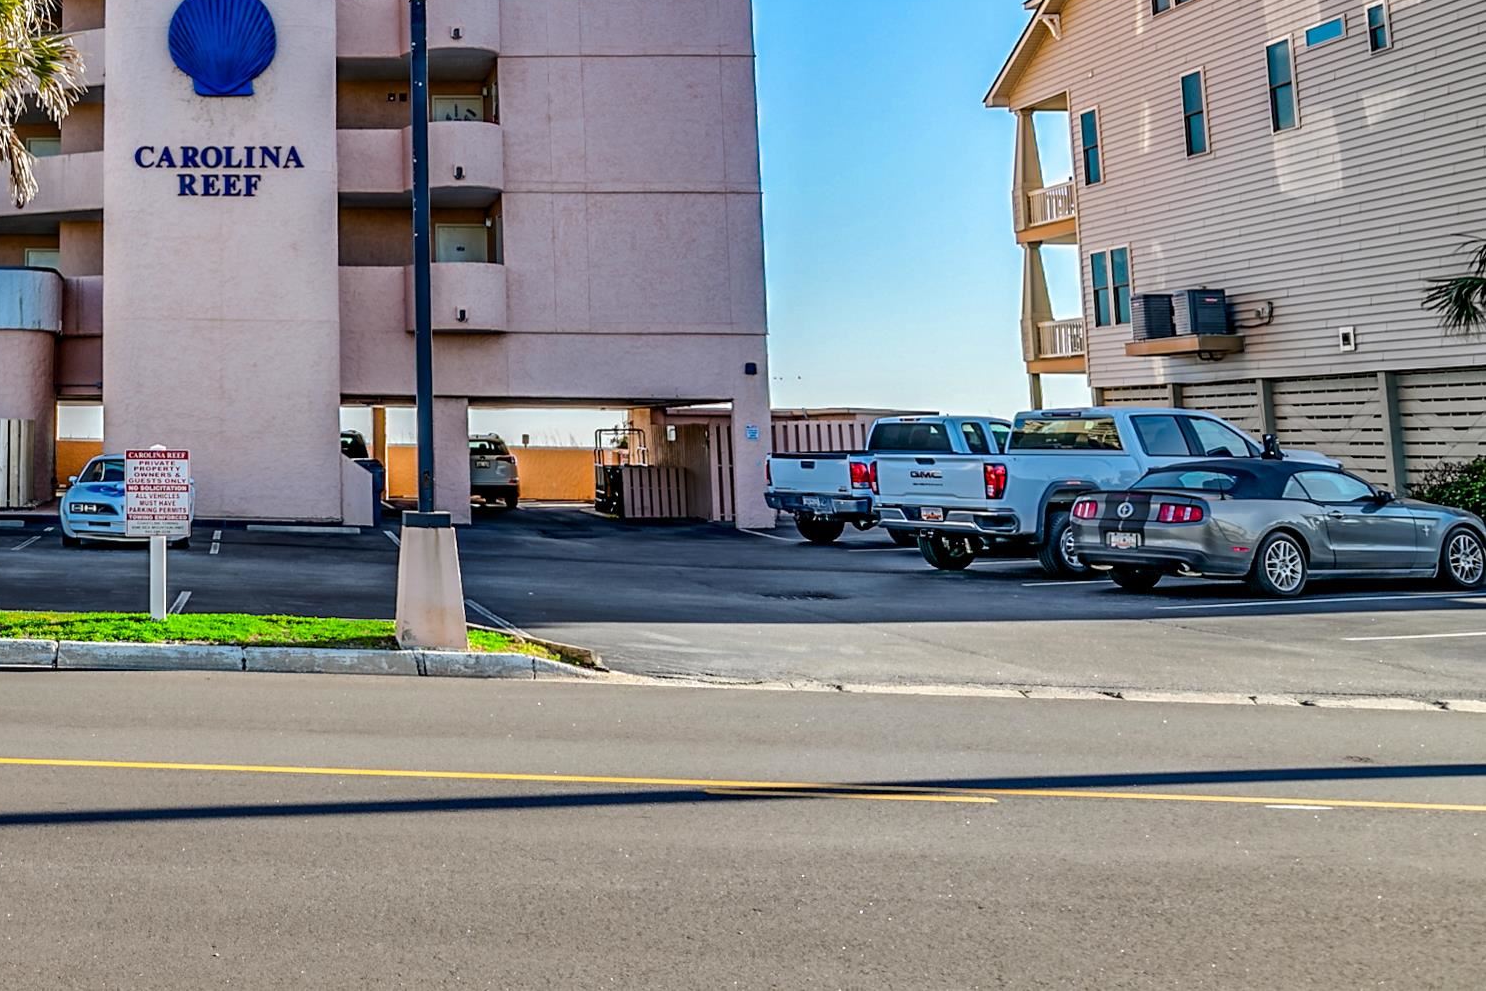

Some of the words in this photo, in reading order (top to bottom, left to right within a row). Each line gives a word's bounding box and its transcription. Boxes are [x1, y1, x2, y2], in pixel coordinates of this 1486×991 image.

[134, 145, 305, 169] CAROLINA
[177, 173, 262, 197] REEF
[910, 470, 943, 478] GMC
